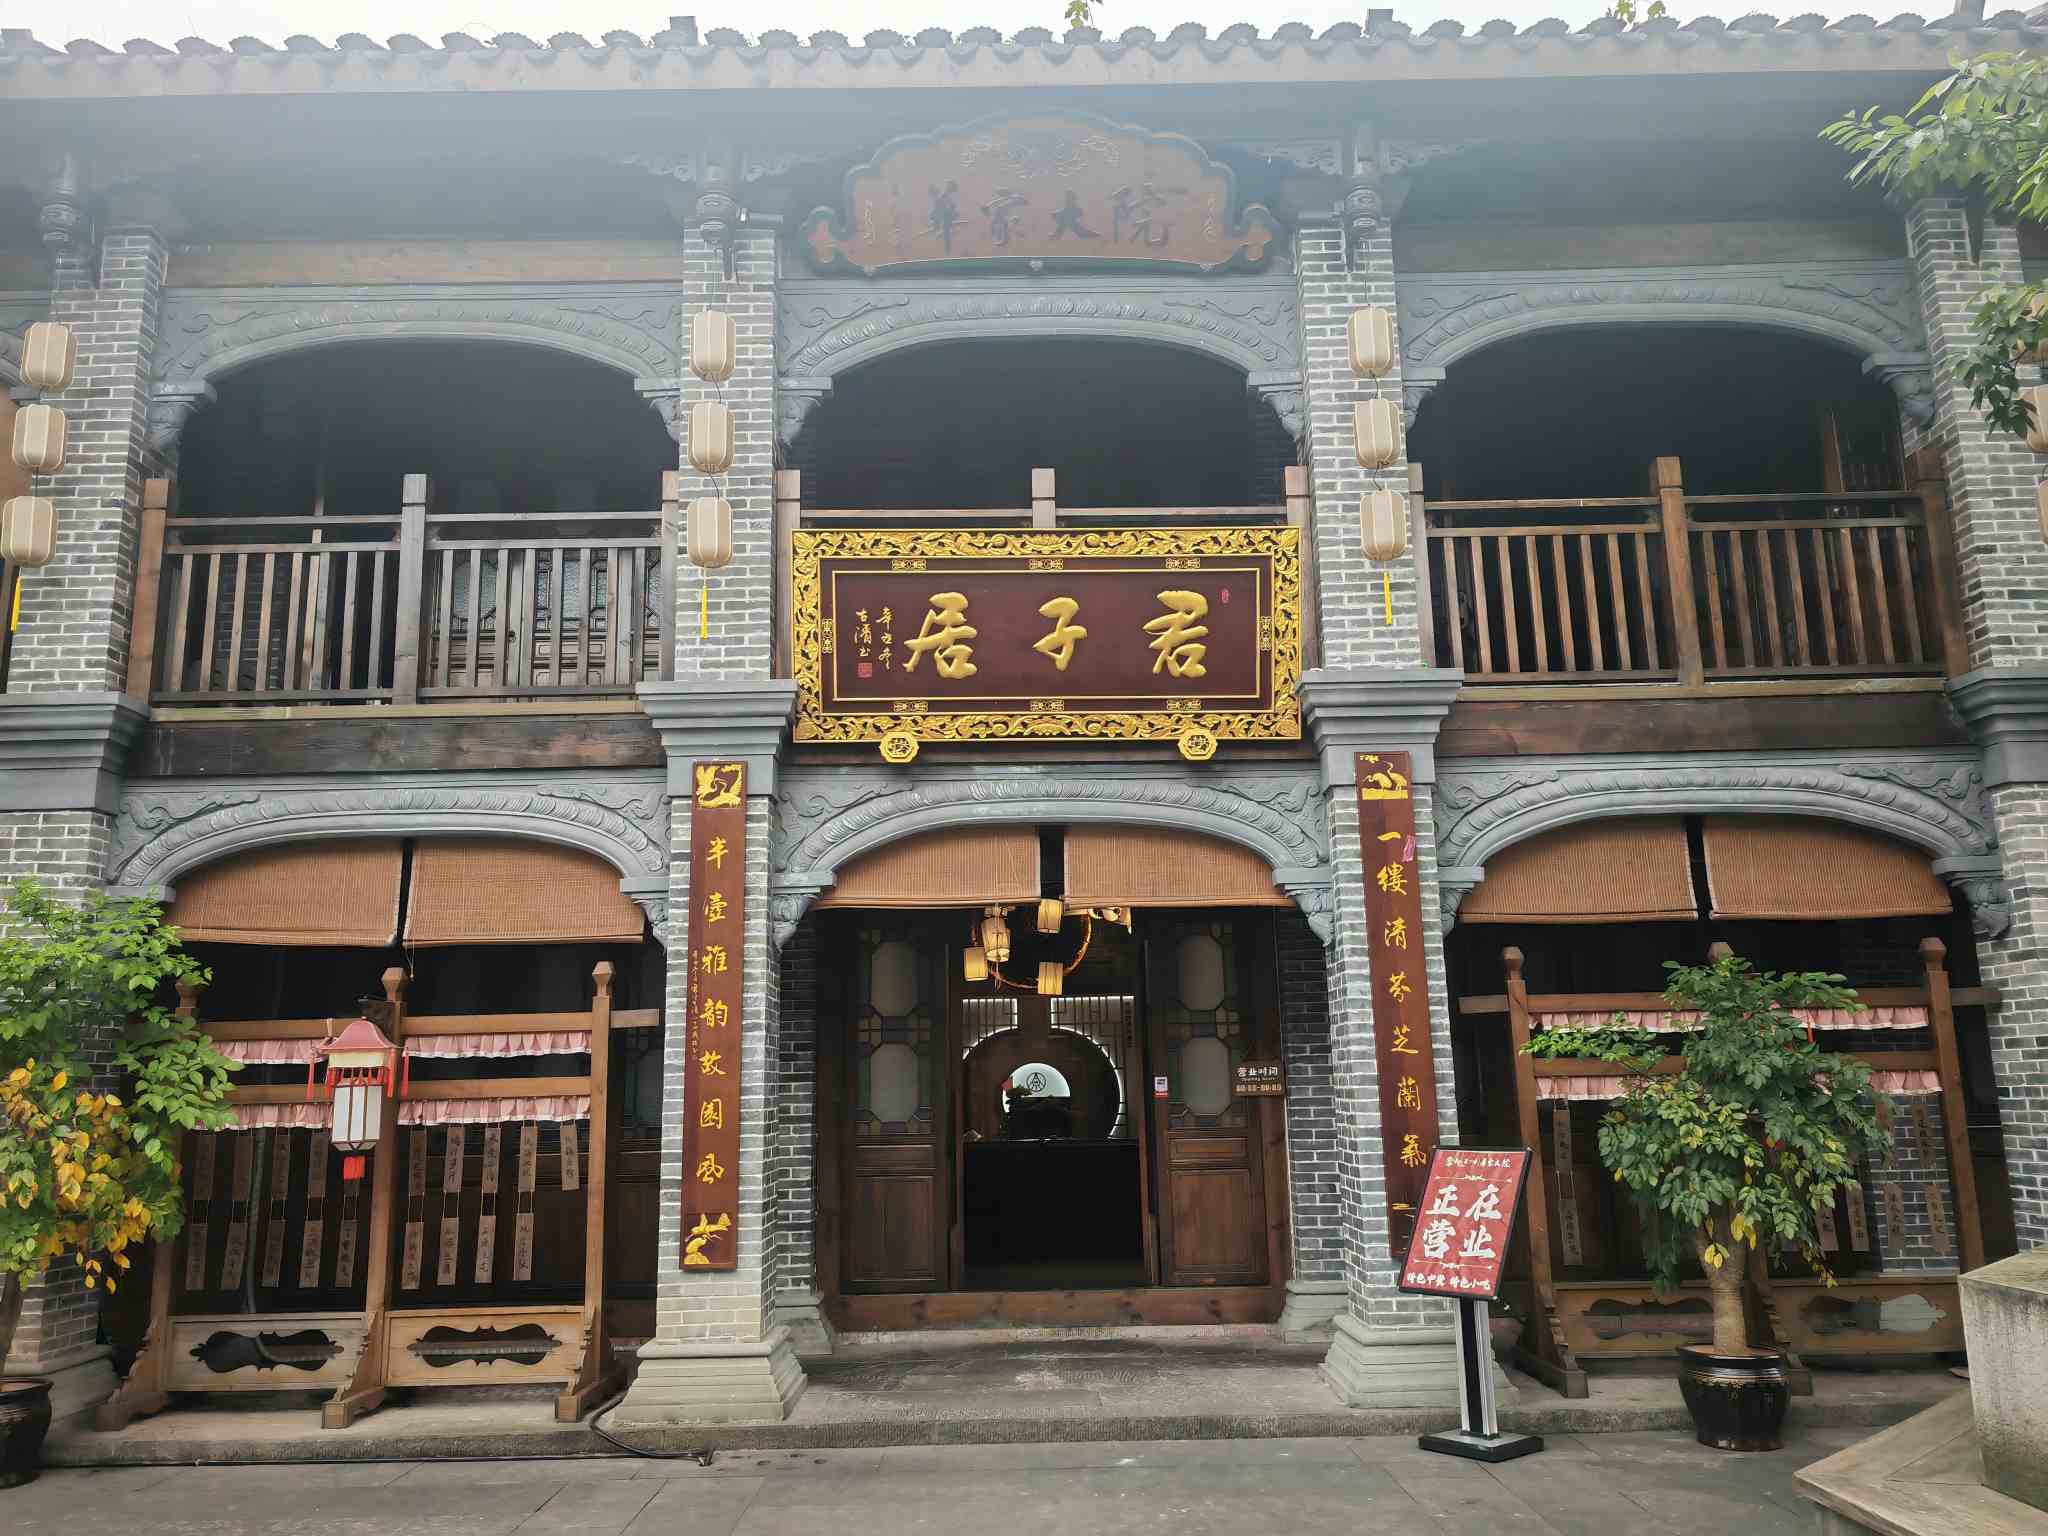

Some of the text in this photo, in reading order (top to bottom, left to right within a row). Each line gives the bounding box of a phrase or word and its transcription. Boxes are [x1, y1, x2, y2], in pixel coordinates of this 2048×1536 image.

[904, 590, 1209, 679] 君子居
[1425, 1184, 1503, 1221] 正在
[1423, 1219, 1496, 1259] 营业
